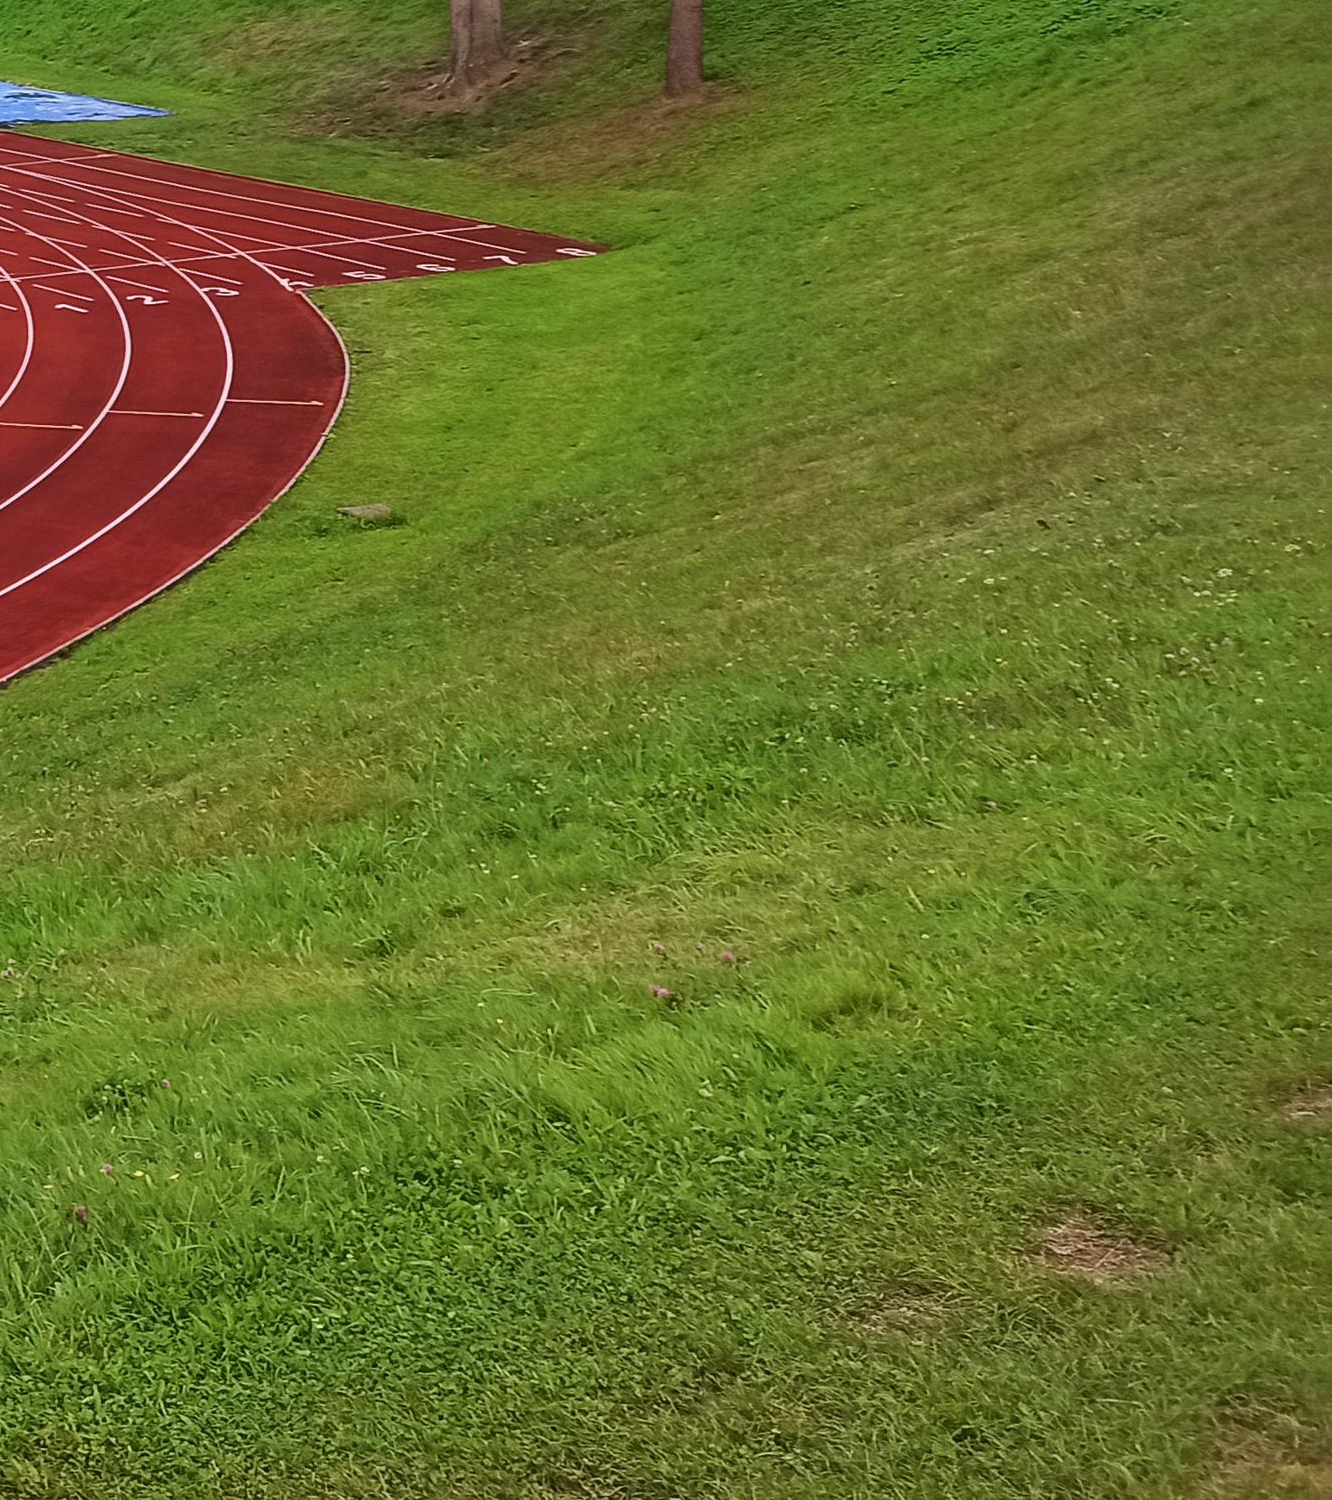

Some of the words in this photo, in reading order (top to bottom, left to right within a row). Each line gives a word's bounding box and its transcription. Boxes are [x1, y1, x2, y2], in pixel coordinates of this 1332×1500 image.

[555, 247, 597, 257] 8
[482, 254, 519, 265] 7
[415, 263, 456, 273] 6
[342, 270, 386, 280] 5
[200, 286, 240, 297] 3
[125, 294, 170, 306] 2
[54, 303, 89, 313] 1
